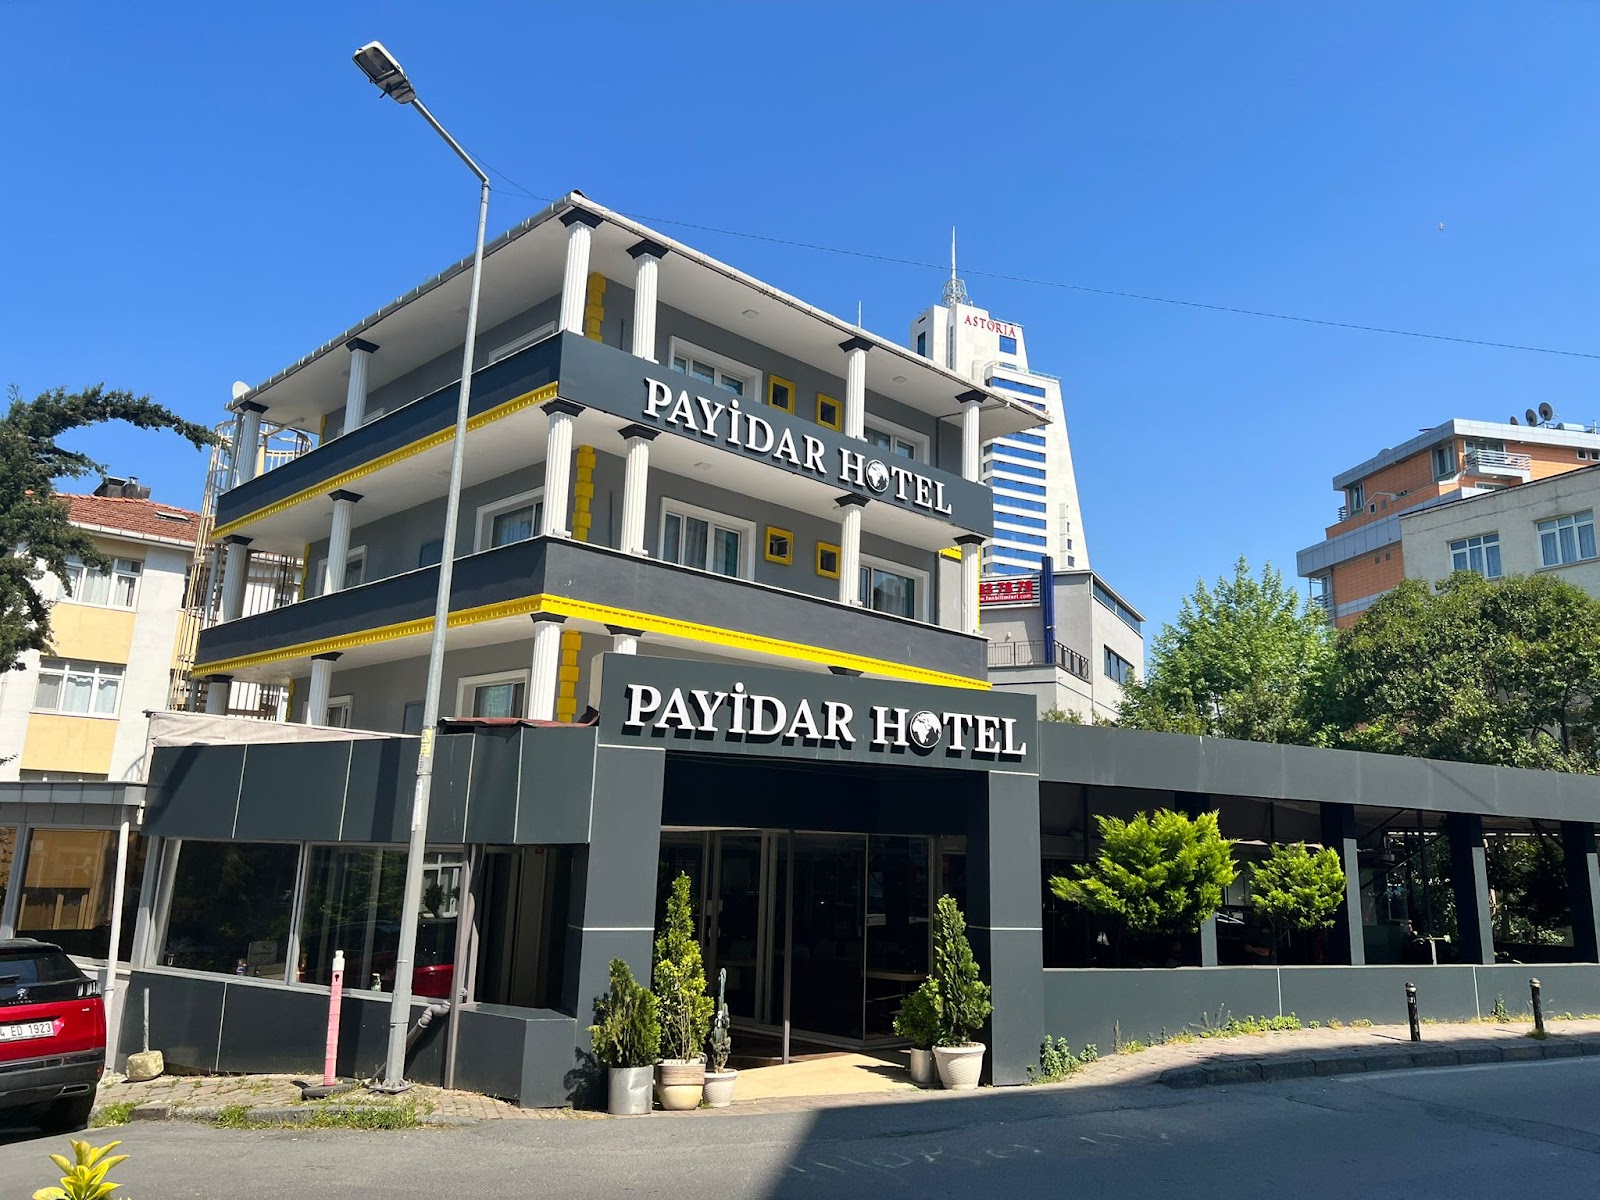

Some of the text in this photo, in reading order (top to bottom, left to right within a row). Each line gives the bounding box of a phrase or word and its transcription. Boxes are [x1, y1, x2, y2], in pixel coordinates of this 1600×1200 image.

[964, 314, 1016, 338] ASTORIA
[643, 377, 953, 515] PAYİDAR HOTEL
[626, 681, 1027, 756] PAYİDAR HOTEL
[11, 1025, 23, 1036] ED
[28, 1023, 51, 1033] 1923
